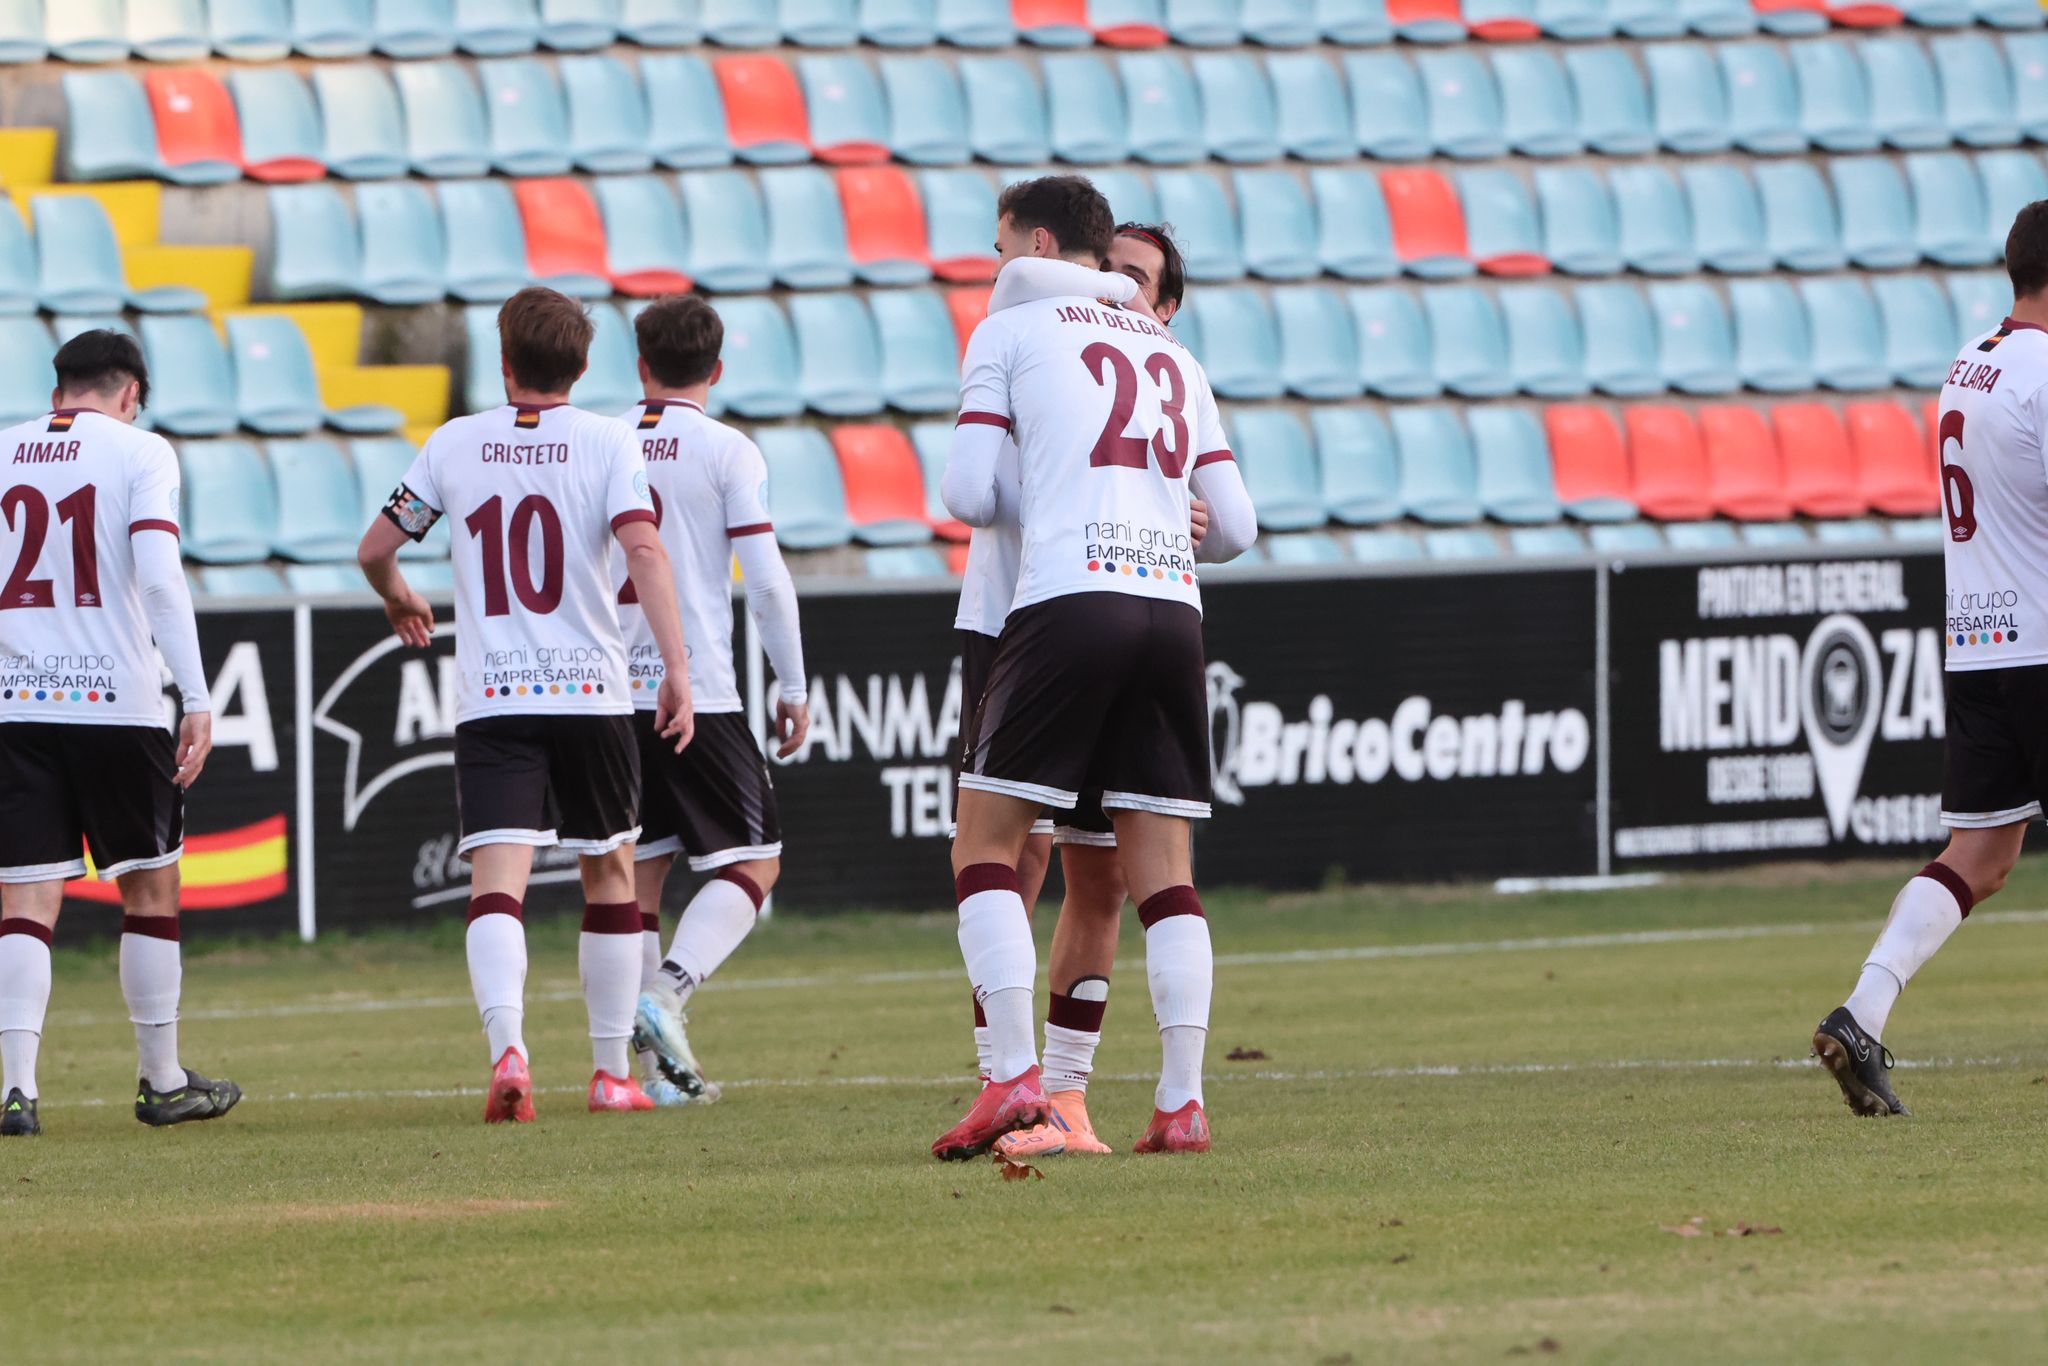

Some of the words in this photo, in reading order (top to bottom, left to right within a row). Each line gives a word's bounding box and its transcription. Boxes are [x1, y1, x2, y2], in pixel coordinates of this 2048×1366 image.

[1056, 306, 1100, 325] JAVI
[1960, 362, 2002, 394] LARA
[1080, 341, 1189, 479] 23
[13, 440, 81, 465] AIMAR
[481, 442, 569, 466] CRISTETO
[1939, 410, 1977, 542] 6
[0, 483, 103, 610] 21
[1085, 520, 1132, 543] nani
[1139, 528, 1190, 552] grup
[465, 494, 565, 617] 10
[1960, 590, 2018, 616] grupo
[1946, 612, 2018, 633] RESARIAL
[43, 654, 115, 675] grupo
[484, 643, 528, 667] nani
[536, 647, 604, 669] grupo
[0, 674, 117, 690] MPRESARIAL
[483, 667, 605, 685] EMPRESARIAL
[1237, 694, 1590, 787] BricoCentro
